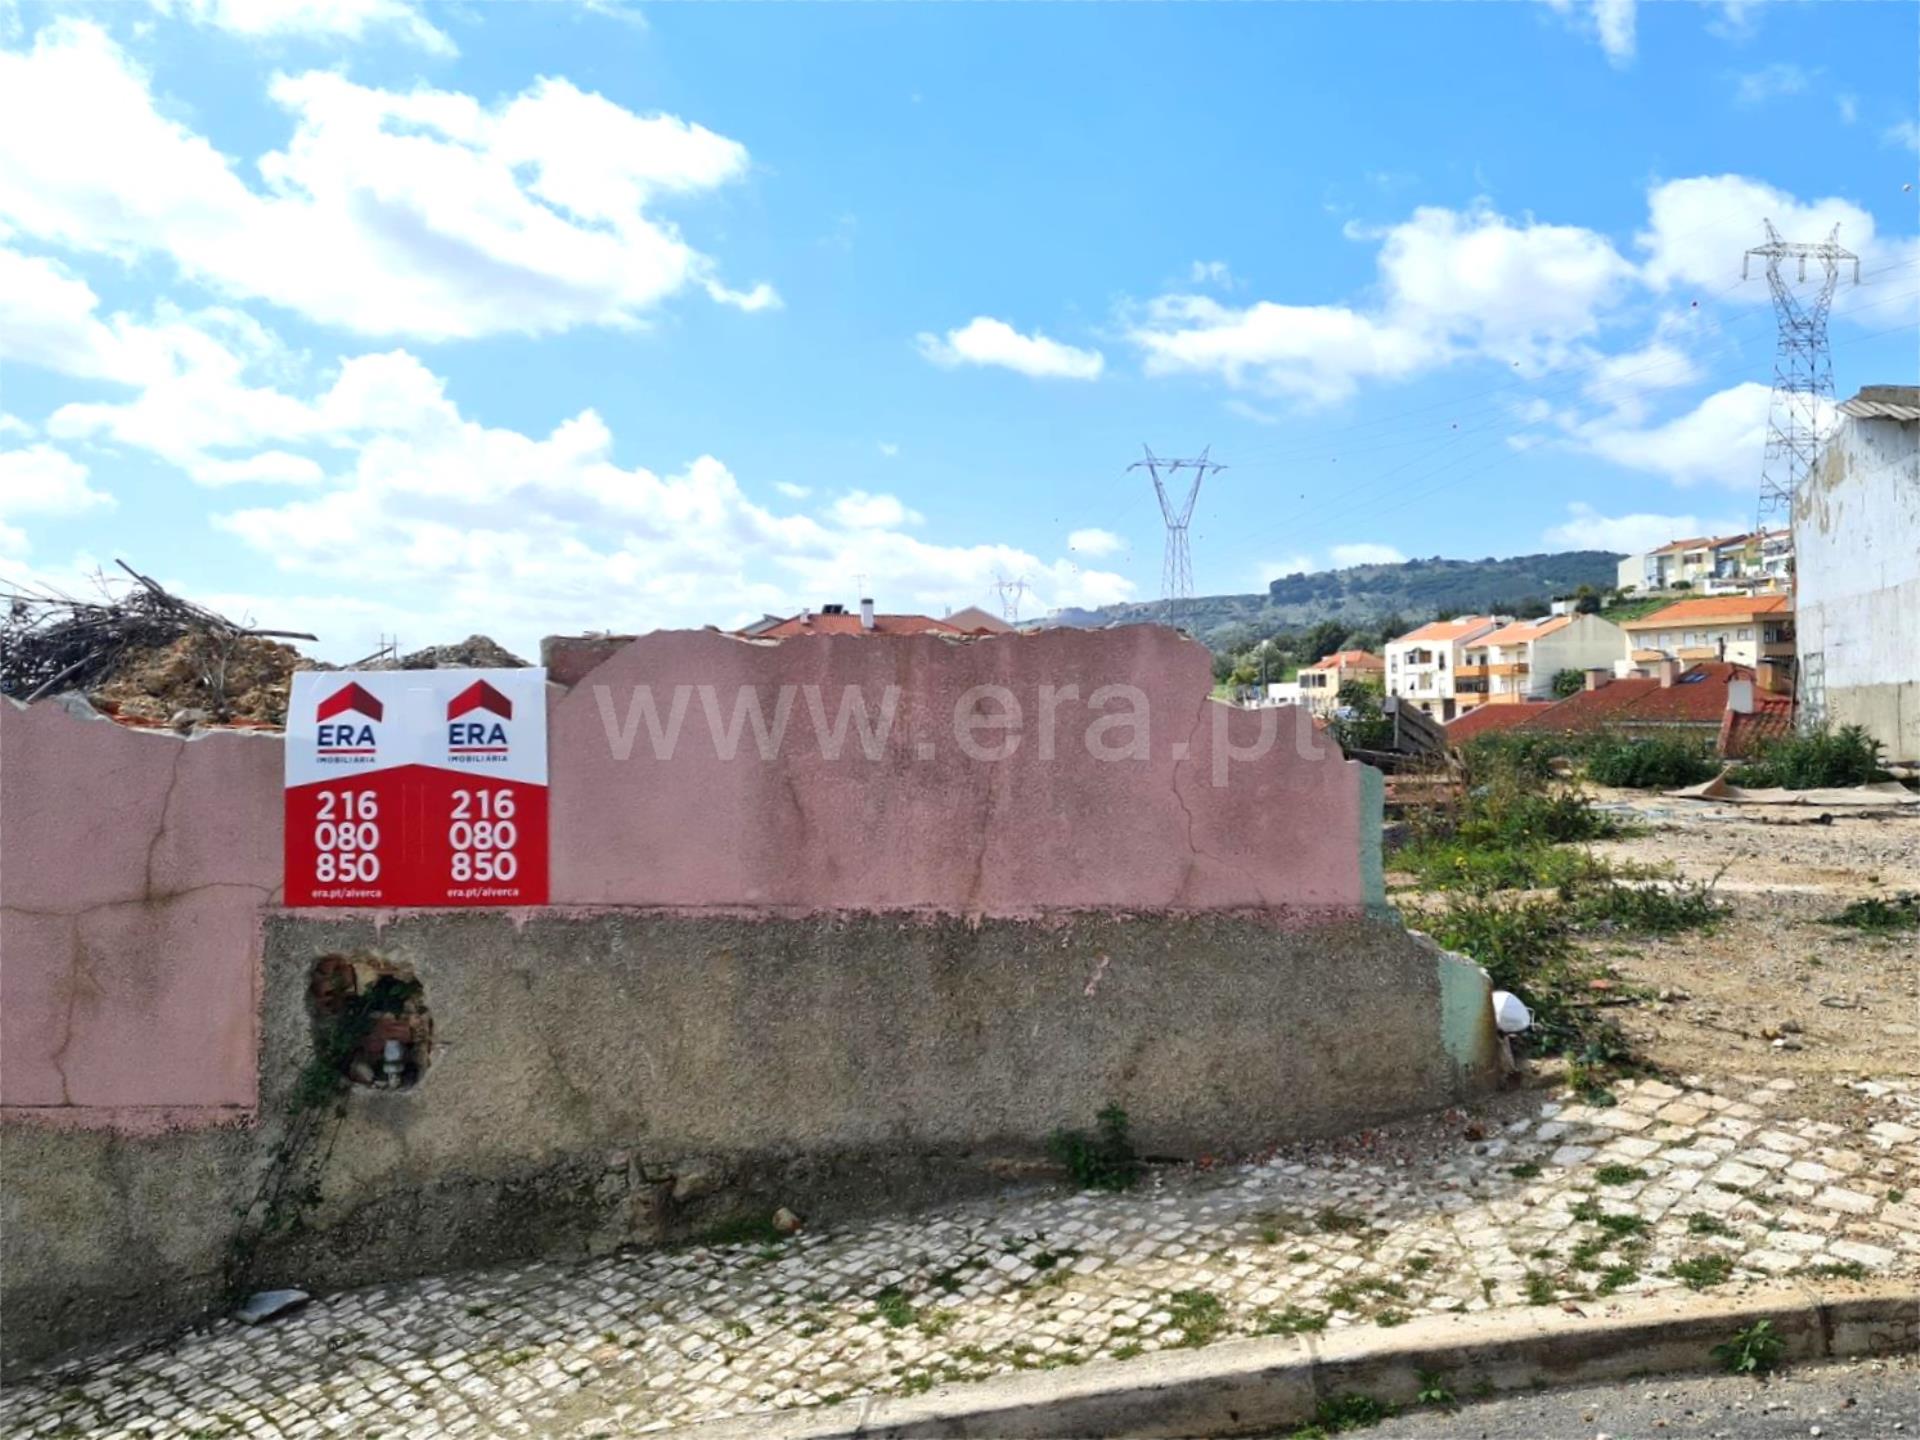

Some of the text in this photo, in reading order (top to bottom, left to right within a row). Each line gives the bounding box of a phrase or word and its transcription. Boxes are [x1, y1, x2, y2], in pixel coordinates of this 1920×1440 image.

[317, 725, 375, 746] ERA
[449, 723, 507, 744] ERA
[316, 791, 378, 821] 216
[450, 790, 515, 819] 216
[315, 822, 380, 852] 080
[450, 821, 517, 850] 080
[316, 853, 380, 883] 850
[451, 852, 517, 882] 850
[312, 888, 383, 900] era.pt/alverca
[447, 887, 519, 899] era.pt/alverca
